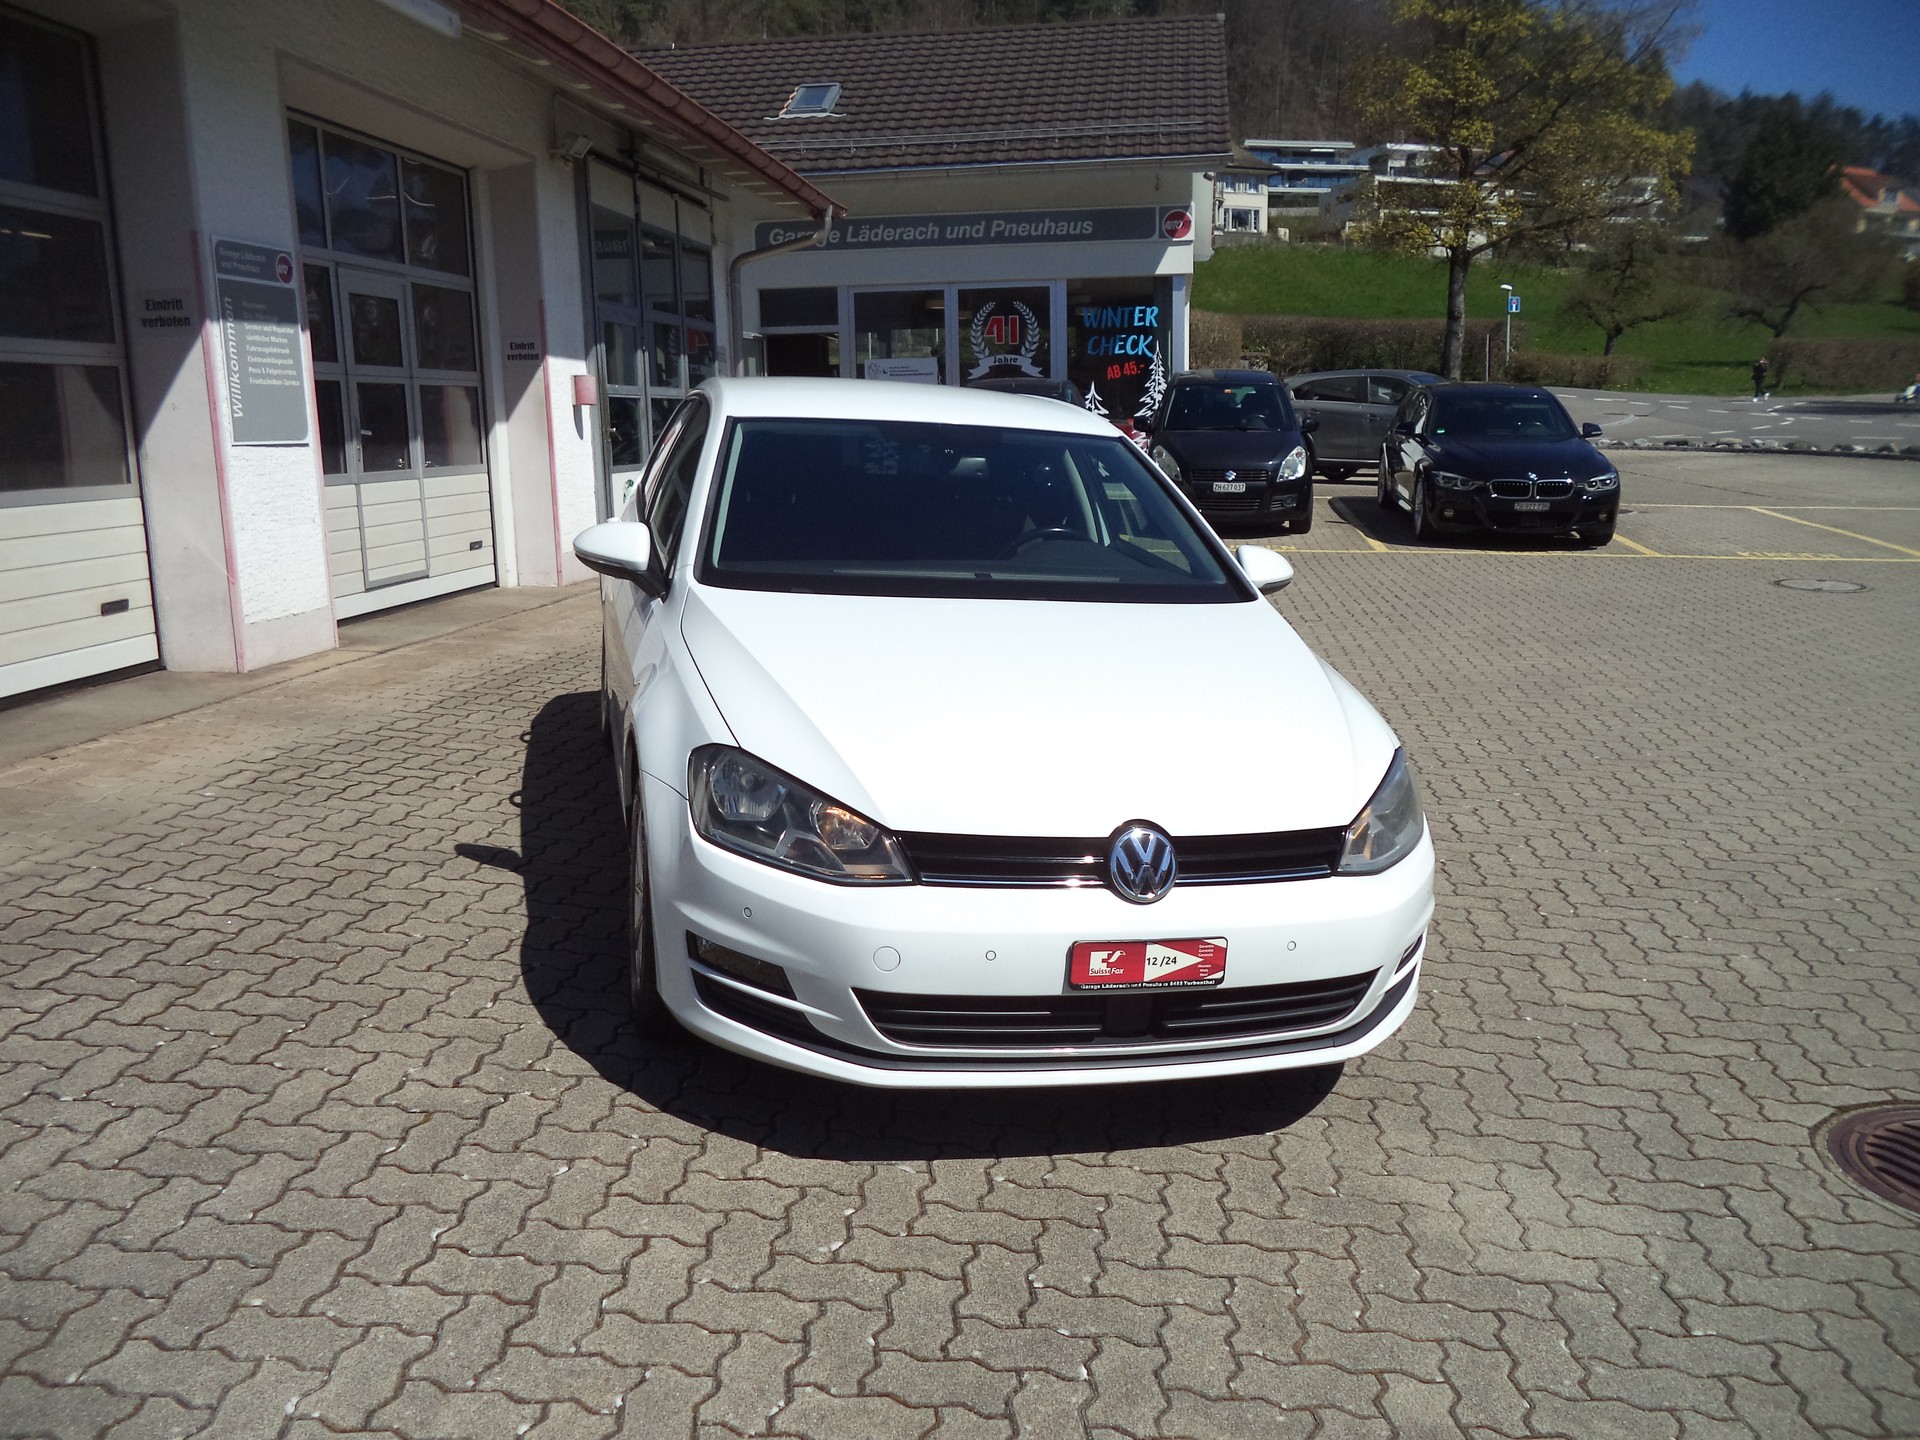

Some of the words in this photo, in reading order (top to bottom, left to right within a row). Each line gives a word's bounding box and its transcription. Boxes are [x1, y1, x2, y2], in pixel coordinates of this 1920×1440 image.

[846, 222, 940, 242] Läderach
[946, 221, 986, 240] und
[990, 218, 1093, 238] Pneuhaus
[145, 298, 184, 311] Eintritt
[141, 316, 191, 328] verboten
[1082, 305, 1159, 328] WINTER
[510, 341, 535, 350] Eintritt
[1087, 334, 1153, 357] CHECK
[225, 297, 244, 418] Willkommen
[506, 353, 540, 361] verboten
[993, 355, 1019, 365] Jahre
[1107, 364, 1121, 380] AB
[1146, 956, 1158, 966] 12
